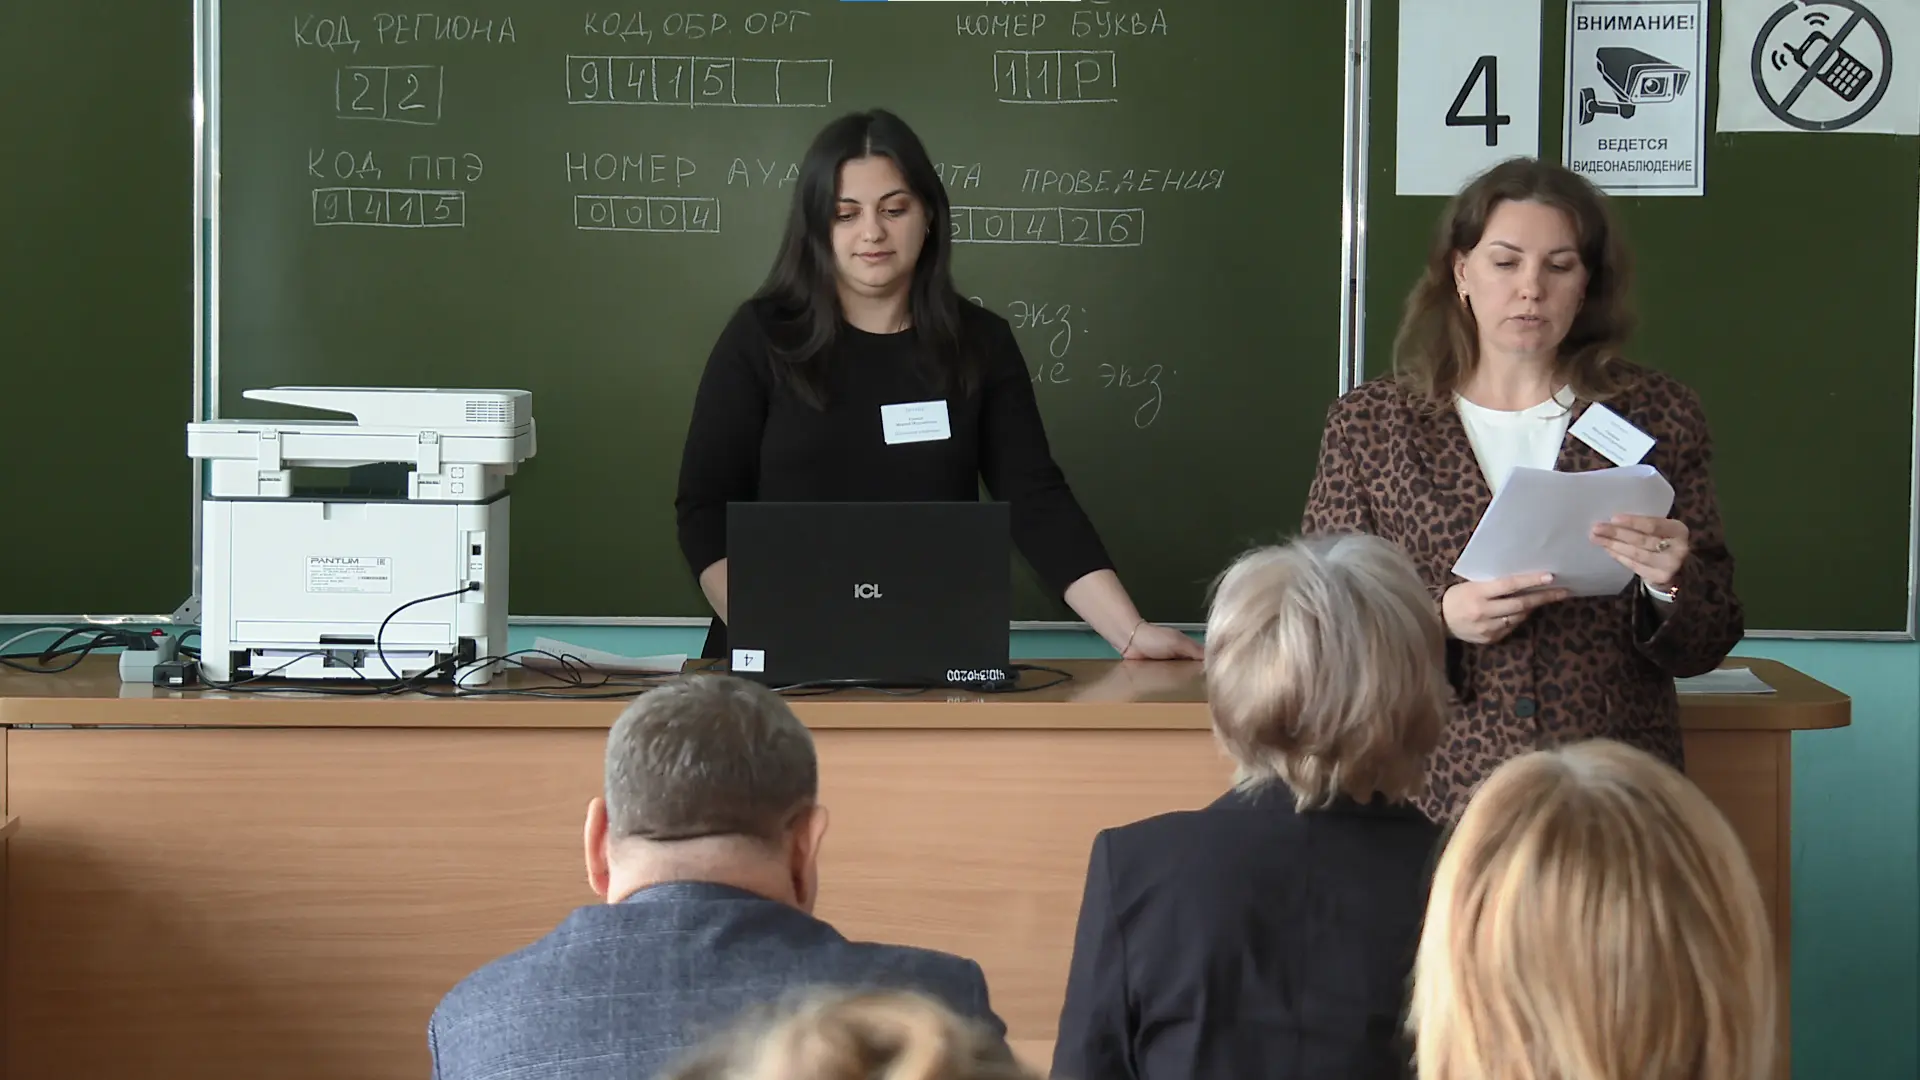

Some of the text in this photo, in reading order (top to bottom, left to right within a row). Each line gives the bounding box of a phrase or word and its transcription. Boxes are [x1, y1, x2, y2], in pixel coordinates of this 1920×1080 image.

[294, 13, 516, 54] КОД РЕГИОНА
[584, 11, 653, 44] КОД
[956, 8, 1168, 38] НОМЕР БУКВА
[1577, 14, 1695, 31] ВНИМАНИЕ!
[1445, 54, 1511, 147] 4
[1597, 138, 1668, 152] ВЕДЕТСЯ
[308, 148, 484, 182] КОД ППЭ
[566, 151, 696, 187] НОМЕР
[933, 162, 1226, 195] АТА ПРОВЕДЕНИЯ
[1572, 157, 1693, 174] ВИДЕОНАБЛЮДЕНИЕ
[590, 202, 709, 229] 0004
[950, 211, 1134, 243] 50426
[854, 583, 883, 599] ICL
[744, 653, 754, 667] 4
